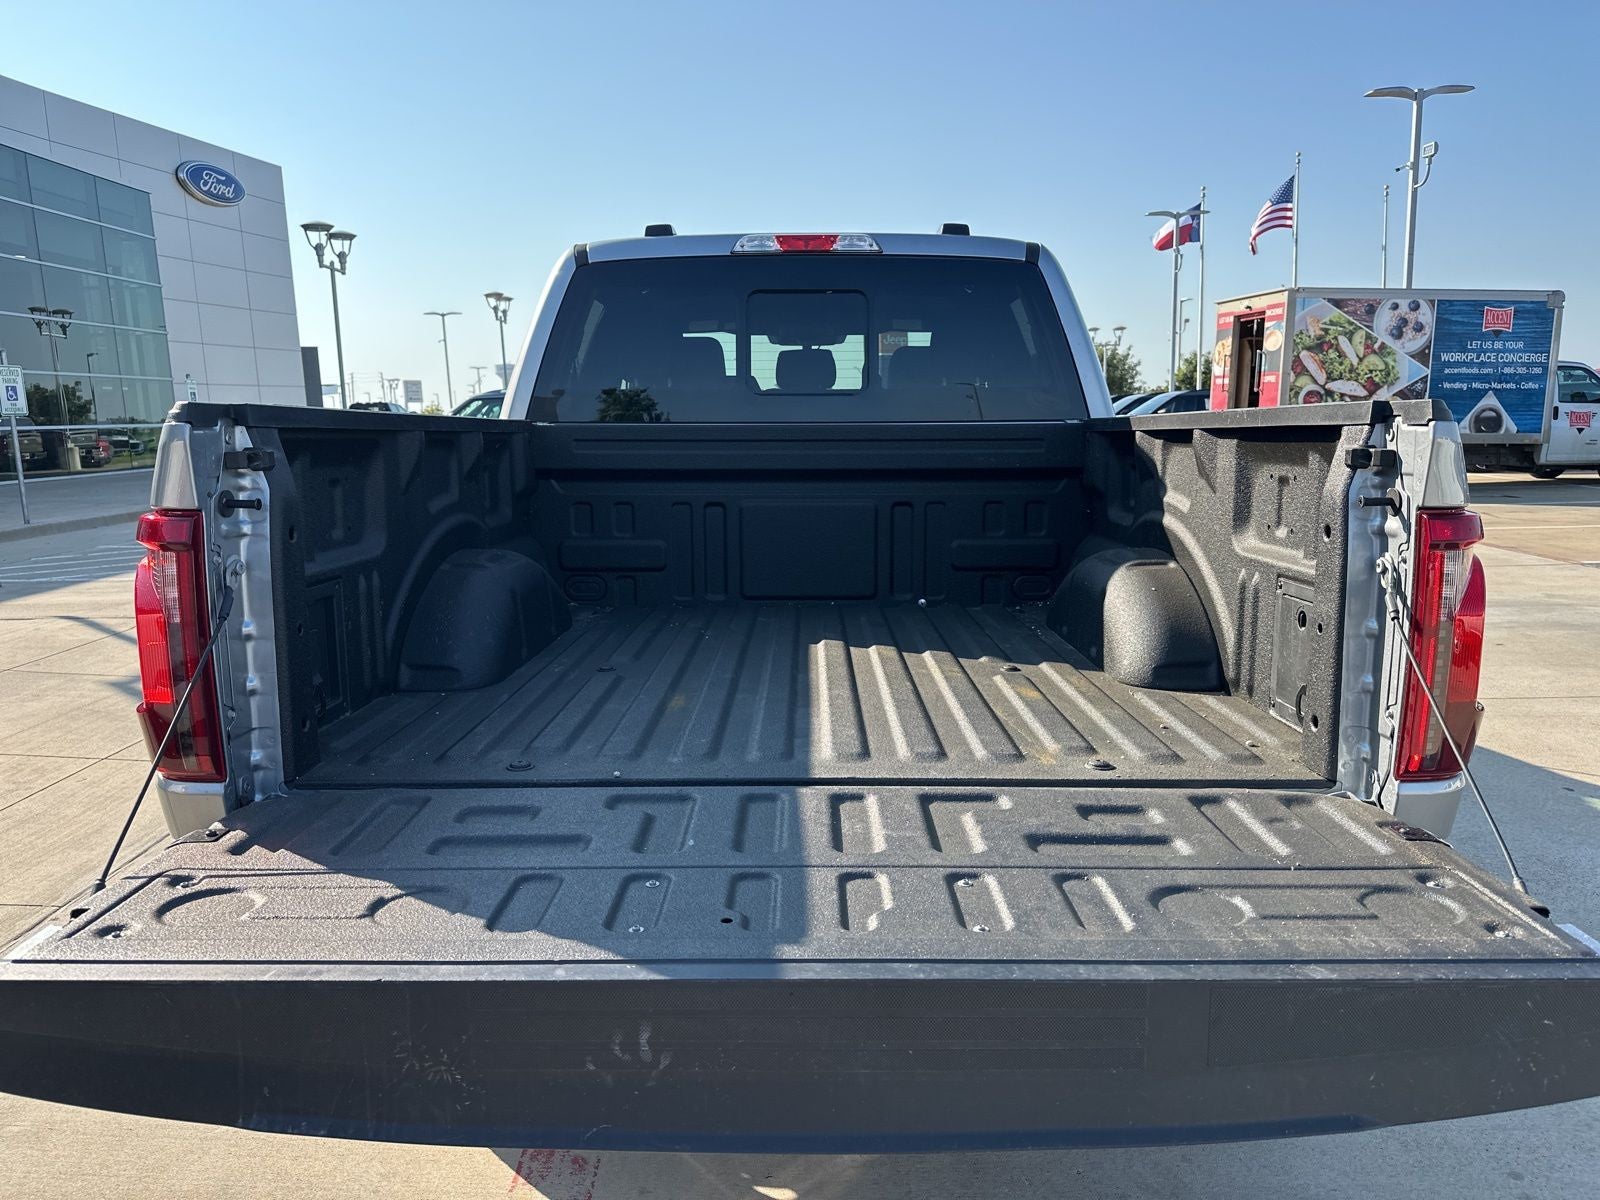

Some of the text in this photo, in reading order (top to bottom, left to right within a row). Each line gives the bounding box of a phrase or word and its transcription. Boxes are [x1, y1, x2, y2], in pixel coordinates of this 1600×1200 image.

[200, 170, 235, 198] Ford
[1486, 310, 1512, 324] ACCENT
[1467, 341, 1524, 349] LET US BE YOUR
[1440, 352, 1548, 362] WORKPLACE CONCIERGE
[1443, 382, 1467, 390] Vending
